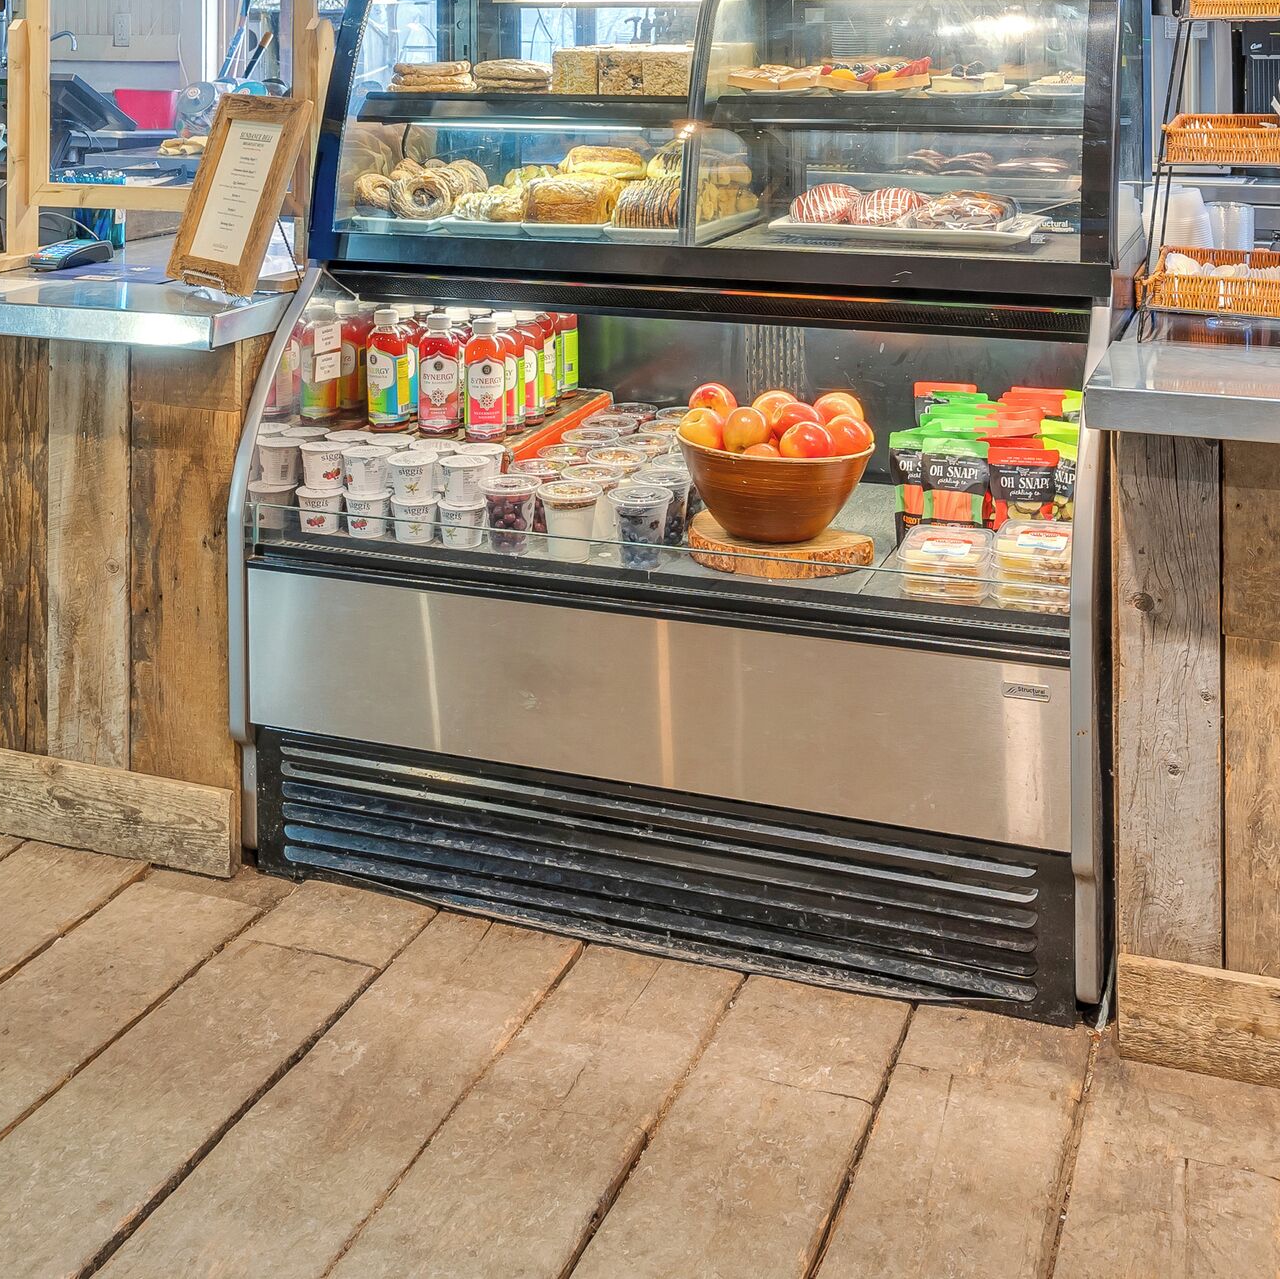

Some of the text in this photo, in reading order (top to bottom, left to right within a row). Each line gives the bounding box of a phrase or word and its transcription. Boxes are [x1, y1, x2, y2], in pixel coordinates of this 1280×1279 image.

[899, 460, 913, 471] OH
[399, 467, 424, 476] siggi's
[930, 465, 978, 480] OH SNAP!
[937, 478, 961, 487] pickling
[1001, 476, 1051, 489] OH SNAP!
[1010, 490, 1034, 498] pickling
